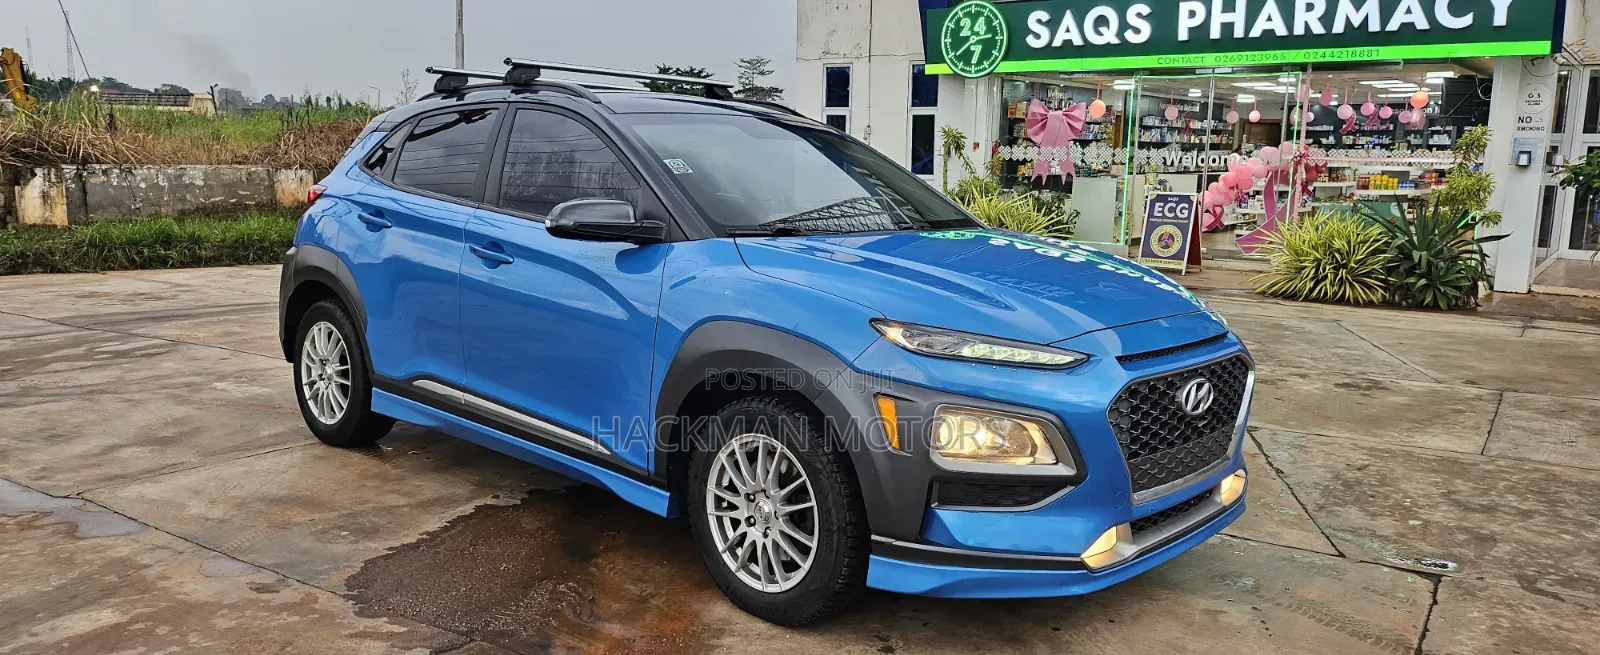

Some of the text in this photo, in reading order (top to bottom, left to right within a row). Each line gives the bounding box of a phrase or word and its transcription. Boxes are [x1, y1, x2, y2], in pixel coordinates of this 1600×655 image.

[959, 16, 987, 38] 24
[1025, 0, 1517, 49] SAQS PHARMACY
[970, 45, 983, 64] 7
[1156, 56, 1206, 66] CONTACT
[1214, 51, 1287, 64] 0269123965
[1303, 48, 1381, 60] 0244218881
[1517, 116, 1533, 124] NO
[1153, 202, 1189, 218] ECG
